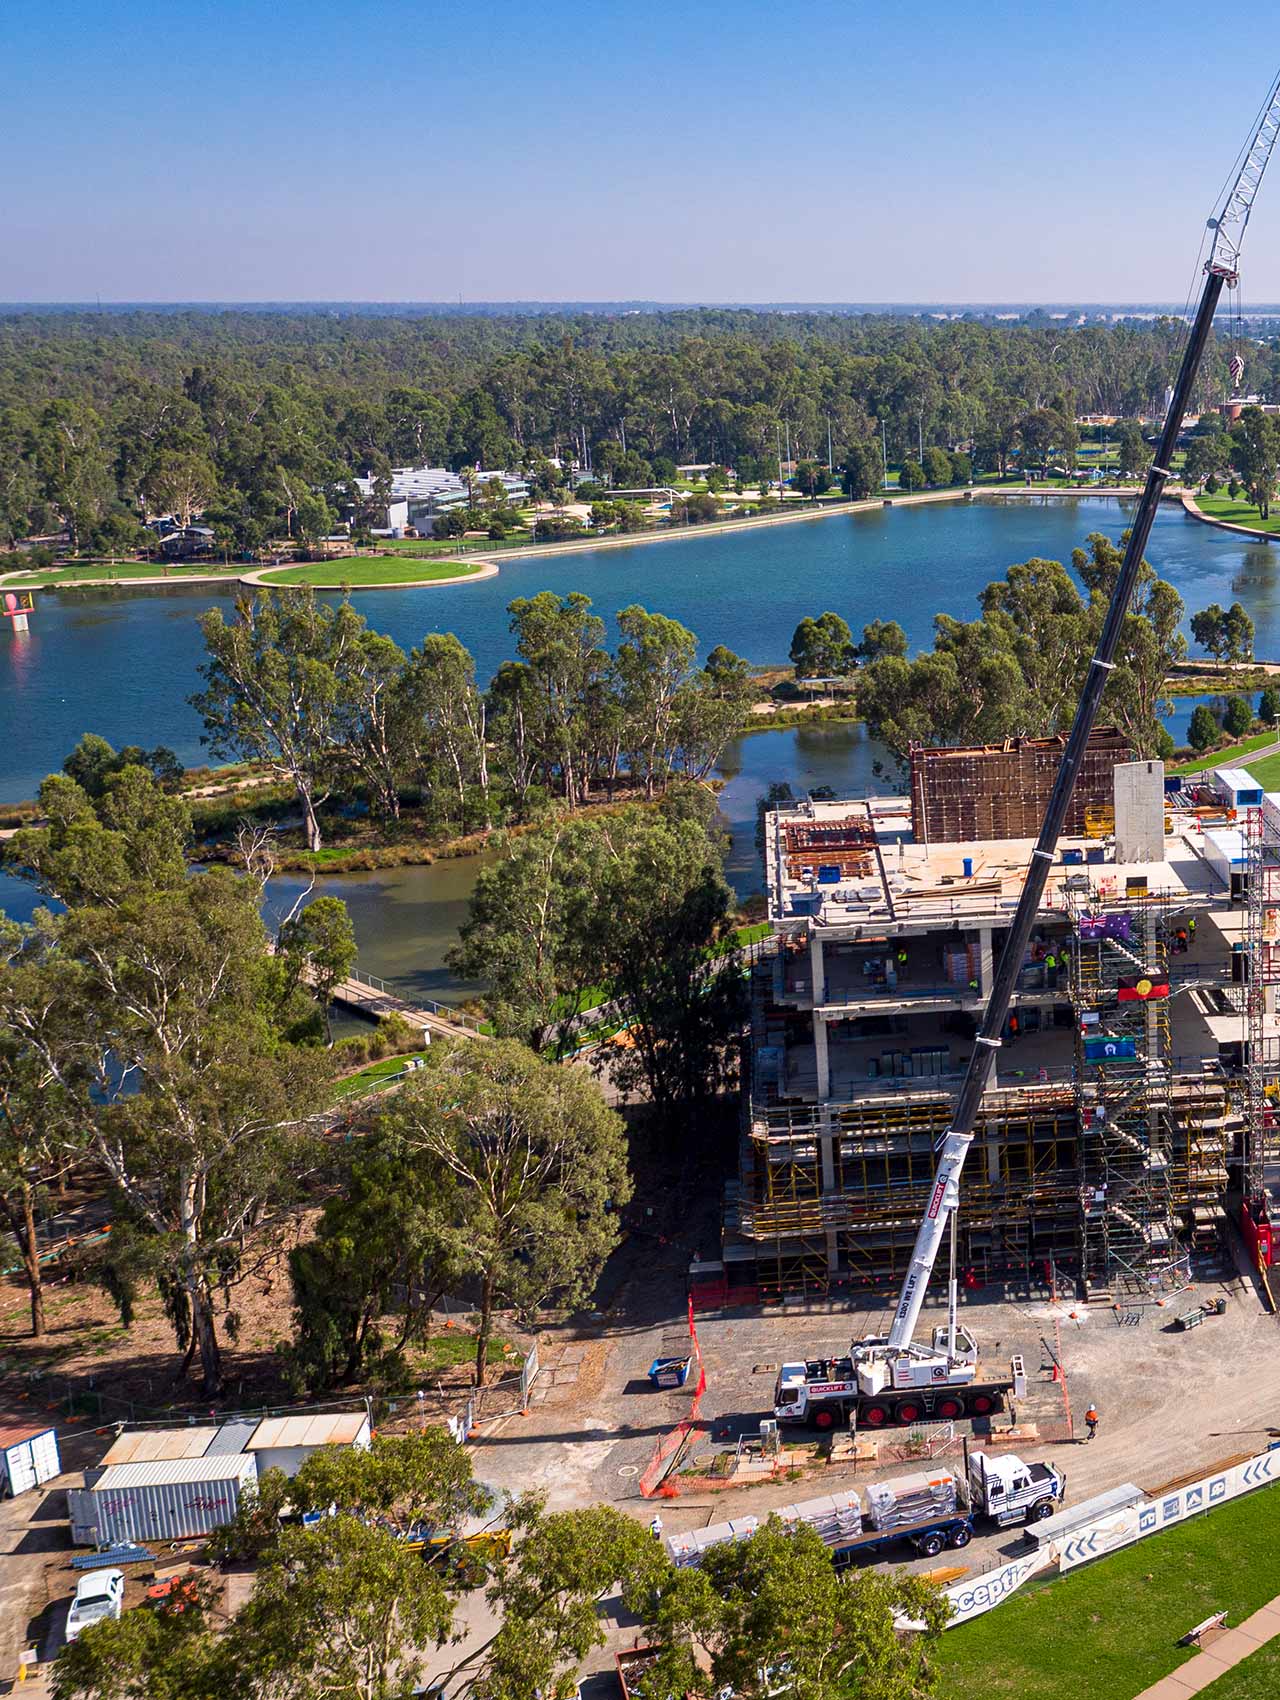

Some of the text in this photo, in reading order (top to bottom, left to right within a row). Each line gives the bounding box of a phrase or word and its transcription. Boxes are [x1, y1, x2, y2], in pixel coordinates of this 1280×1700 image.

[928, 1184, 945, 1218] QUICKLIFT
[908, 1274, 918, 1289] LIFT
[810, 1384, 844, 1393] QUICKLIFT
